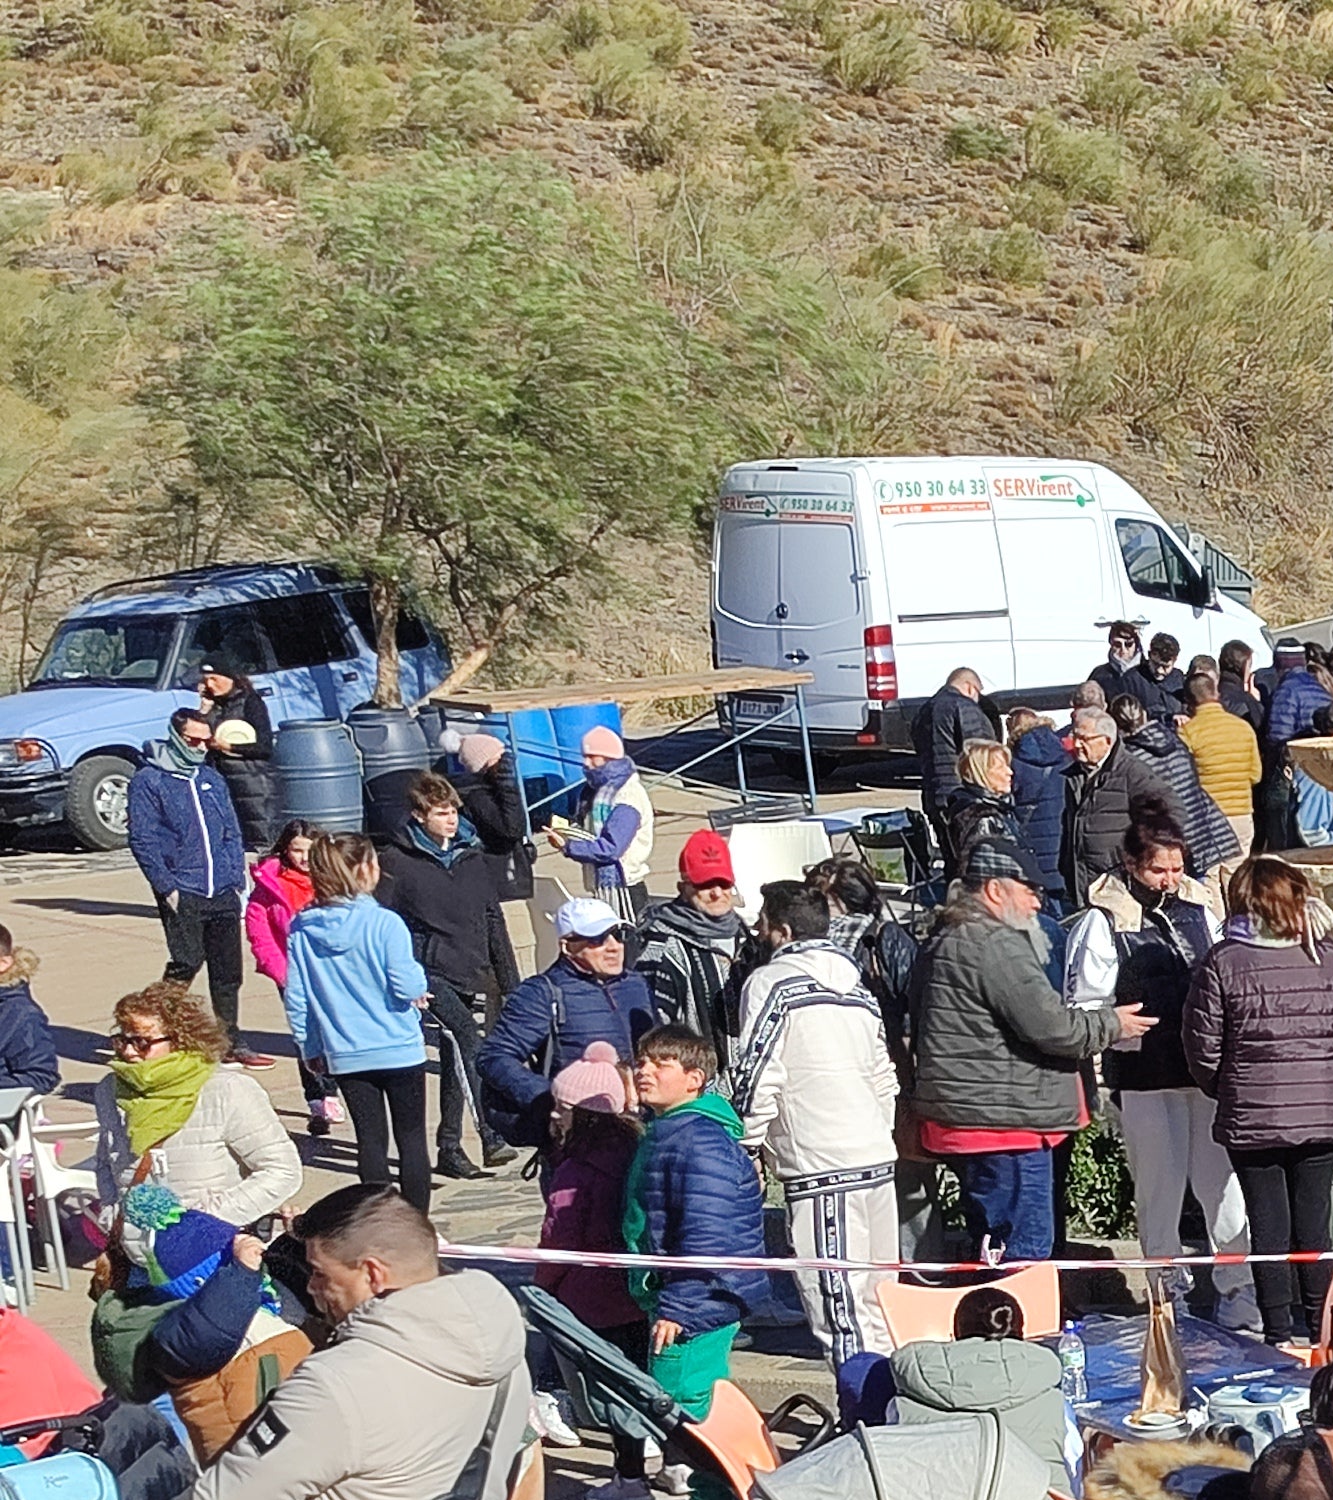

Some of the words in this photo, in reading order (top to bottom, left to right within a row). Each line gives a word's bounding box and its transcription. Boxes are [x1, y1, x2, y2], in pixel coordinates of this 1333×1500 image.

[895, 480, 922, 498] 950
[927, 480, 944, 497] 30
[949, 479, 965, 496] 64
[970, 479, 986, 495] 33
[993, 478, 1074, 497] SERVirent
[791, 497, 808, 509] 950
[811, 499, 823, 511] 30
[825, 500, 838, 512] 64
[841, 500, 854, 513] 33
